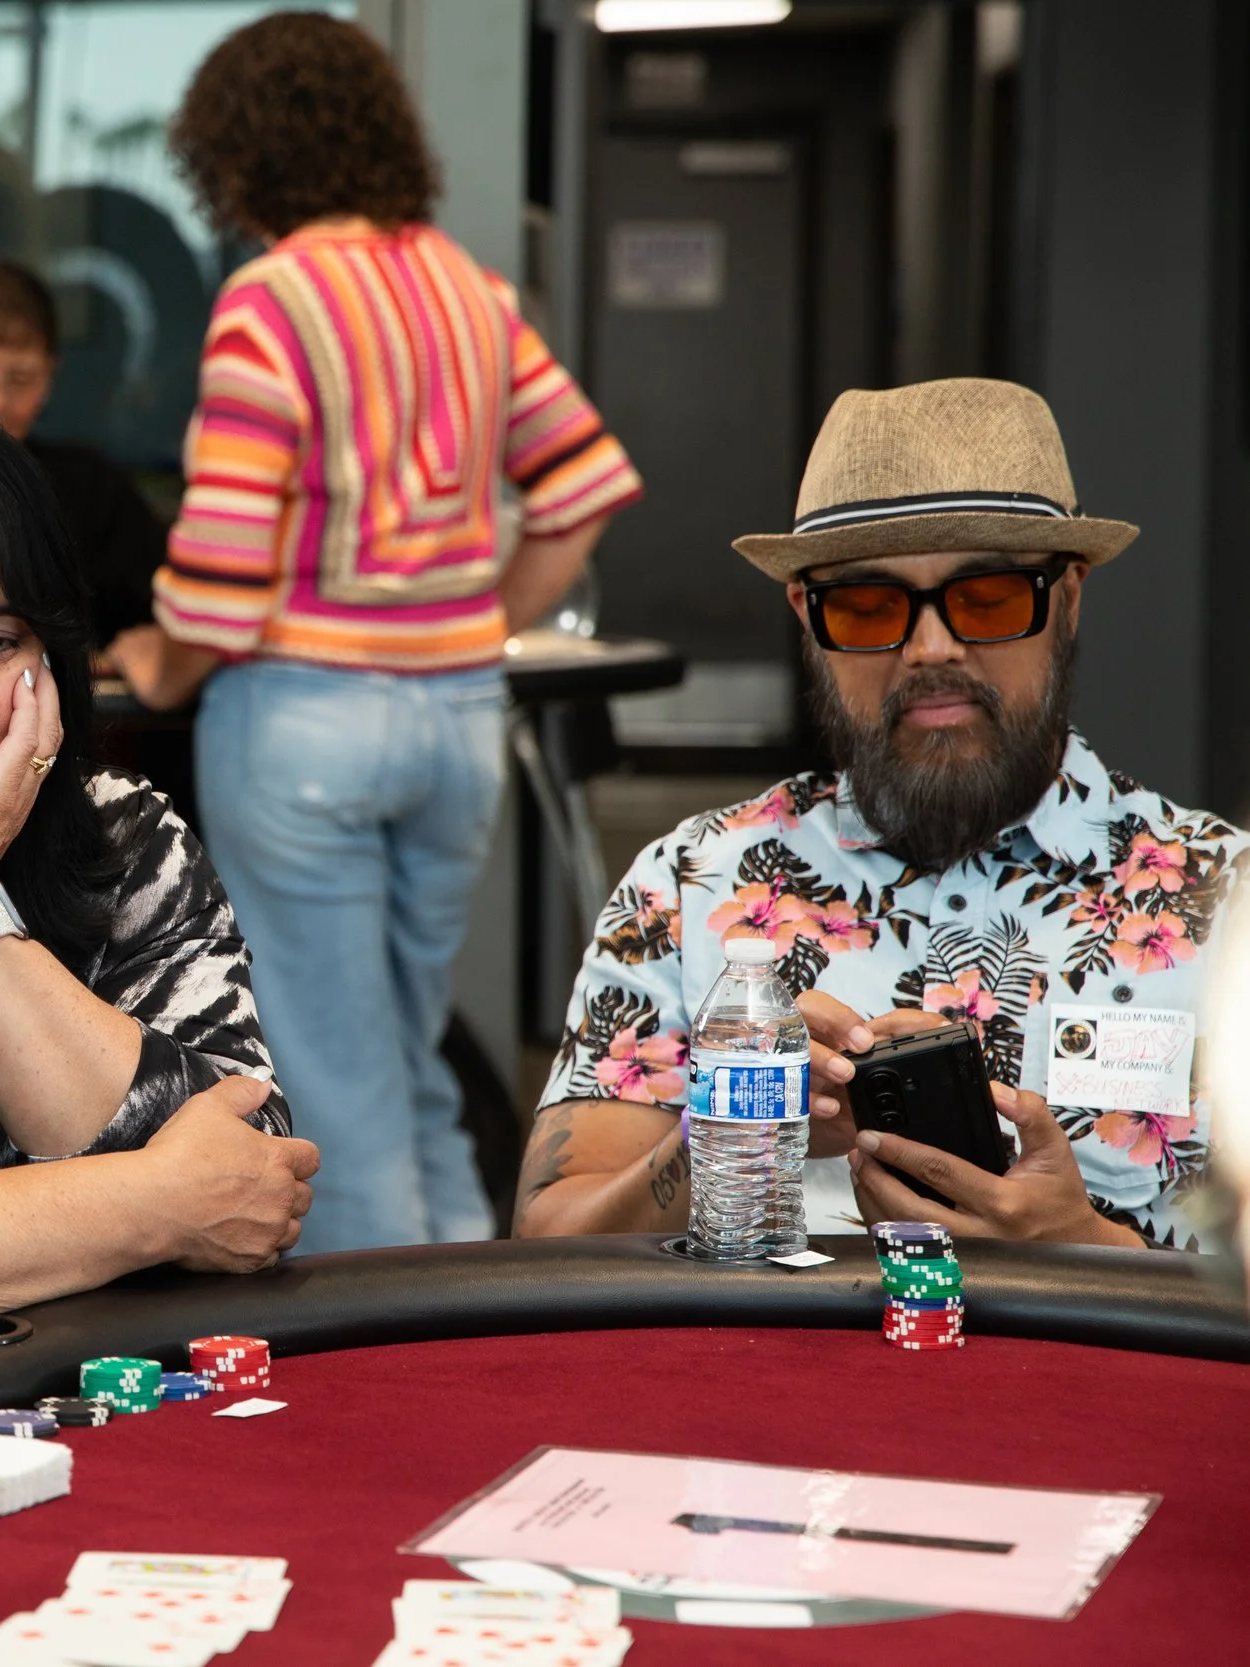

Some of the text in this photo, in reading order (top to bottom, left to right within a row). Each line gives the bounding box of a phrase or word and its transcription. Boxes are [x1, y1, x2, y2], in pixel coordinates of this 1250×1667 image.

[1101, 1012, 1131, 1022] HELLO
[1133, 1013, 1147, 1022] MY
[1150, 1014, 1176, 1025] NAME
[1101, 1028, 1190, 1068] JAY
[1100, 1060, 1115, 1070] MY
[1117, 1061, 1163, 1072] COMPANY
[774, 1094, 785, 1103] CA
